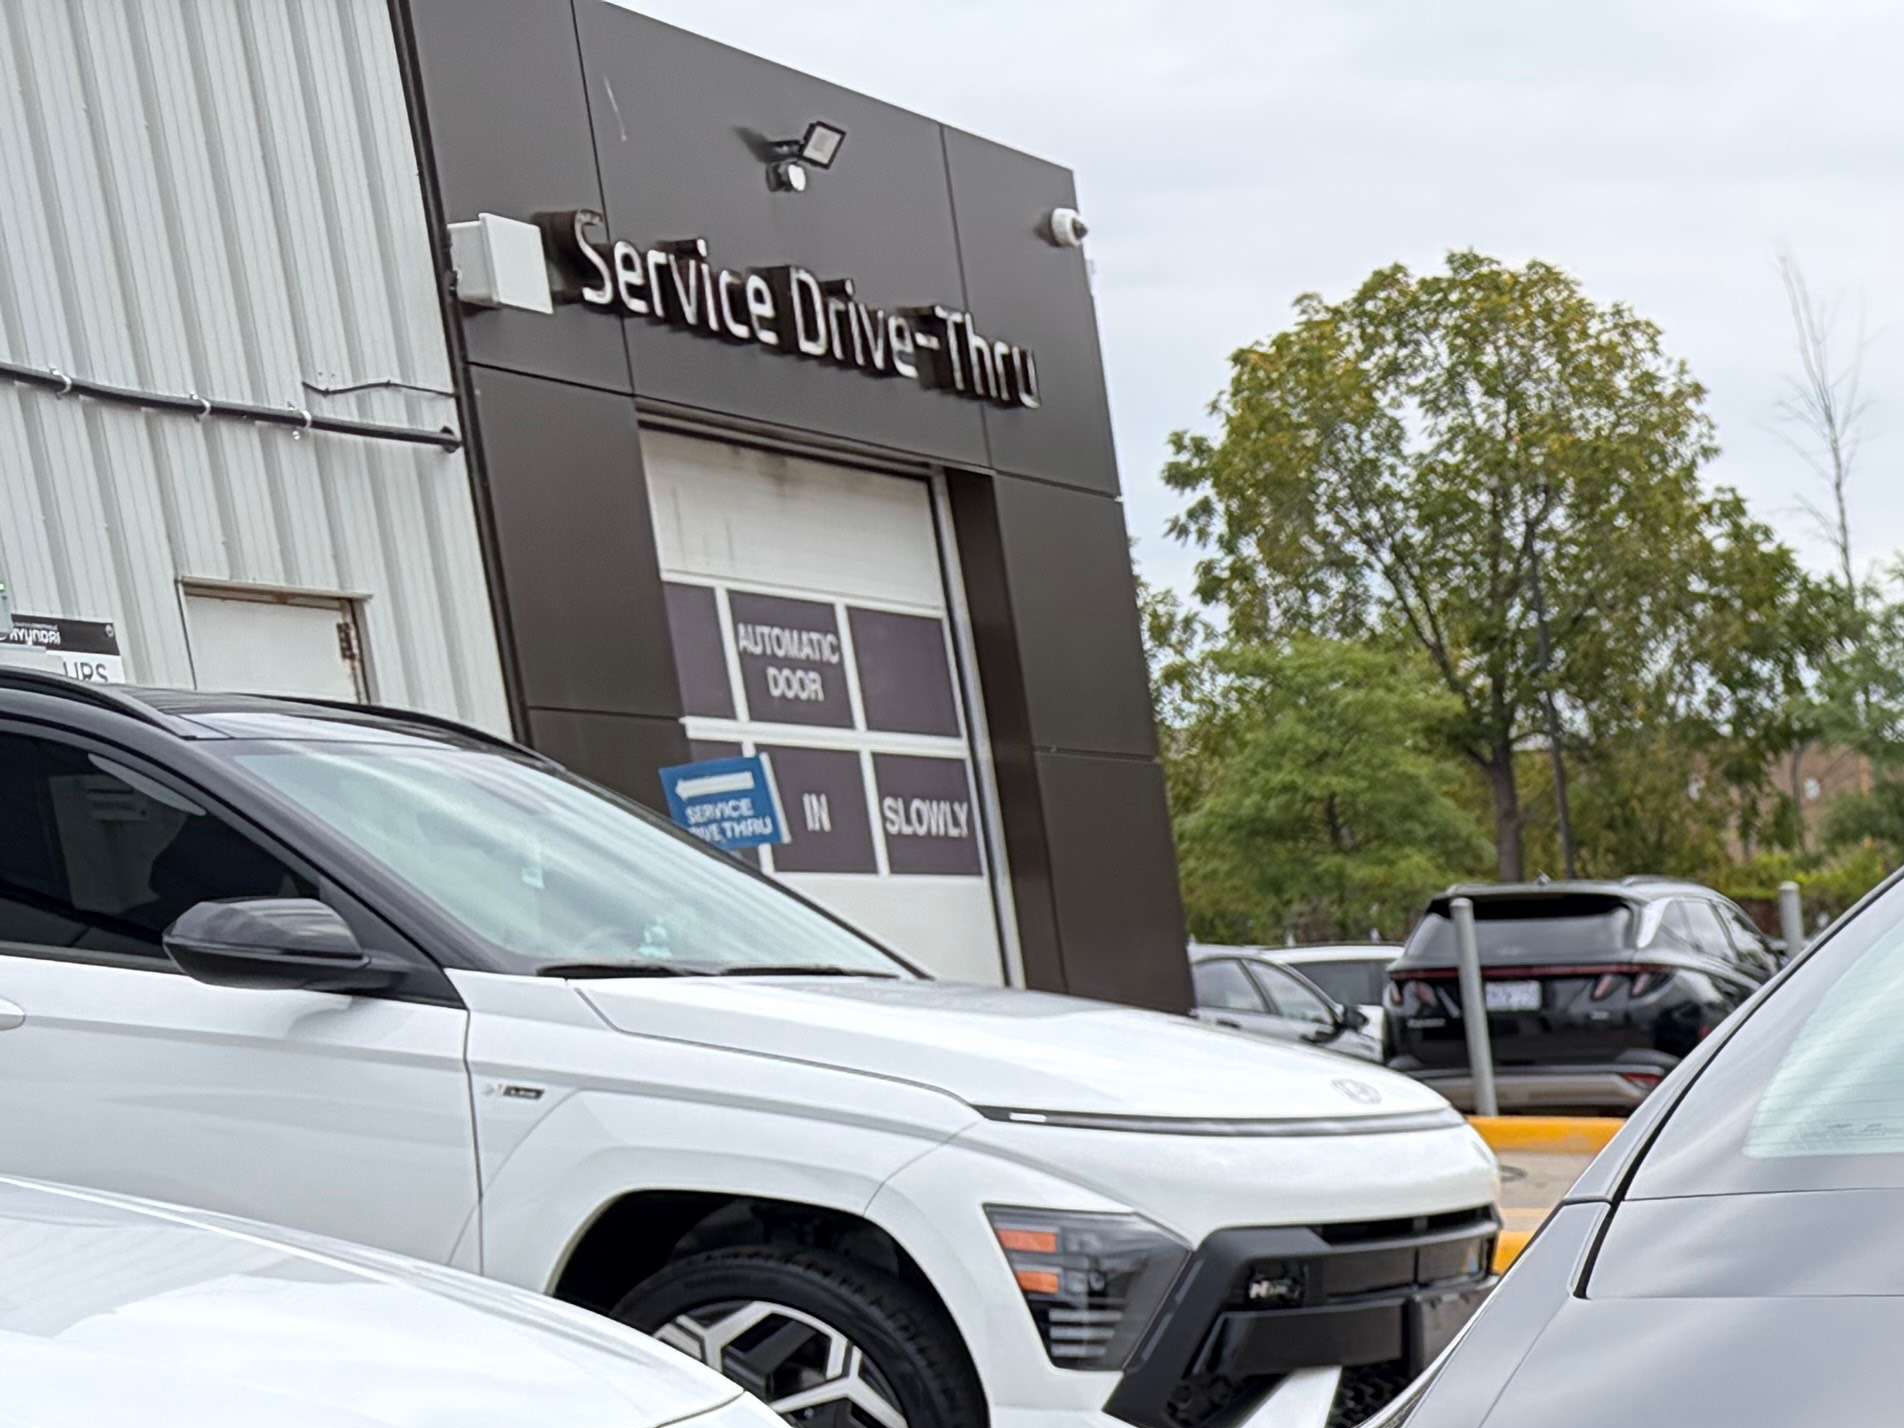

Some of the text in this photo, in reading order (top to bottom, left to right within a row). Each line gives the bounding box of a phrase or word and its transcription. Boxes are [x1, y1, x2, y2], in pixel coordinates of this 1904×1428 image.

[575, 207, 1041, 409] Service Drive-Thru
[737, 623, 840, 664] AUTOMATIC
[767, 667, 824, 701] DOOR
[685, 798, 755, 825] SERVICE
[722, 816, 773, 839] THRU
[803, 793, 832, 833] IN
[883, 797, 969, 838] SLOWLY
